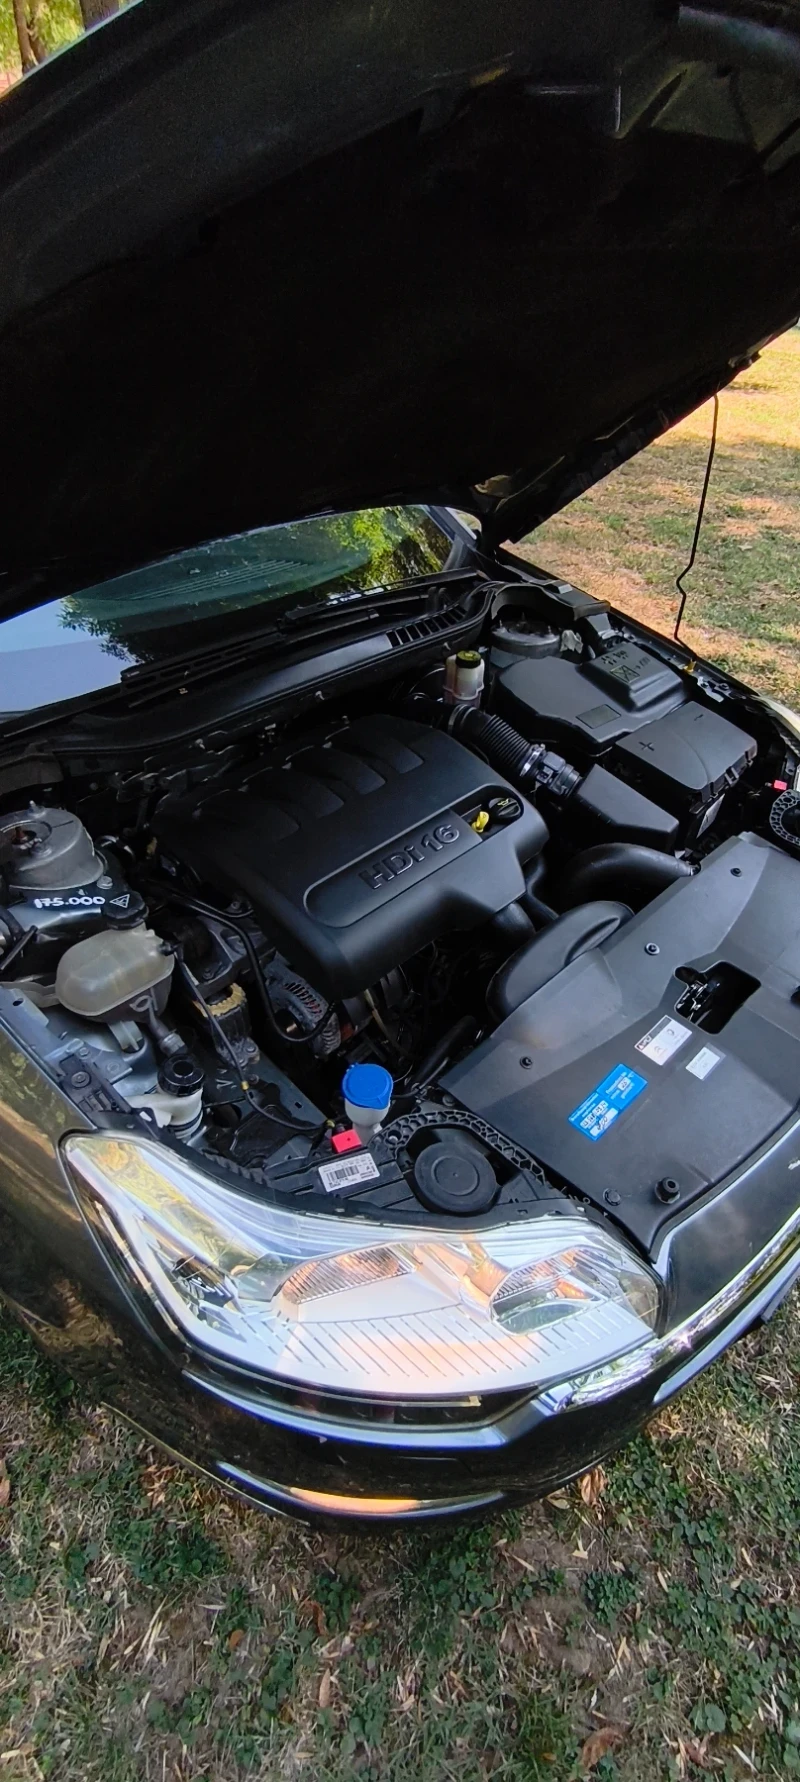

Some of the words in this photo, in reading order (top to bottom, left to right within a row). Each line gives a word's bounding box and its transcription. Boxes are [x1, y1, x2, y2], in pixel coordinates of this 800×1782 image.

[358, 845, 426, 889] HDi
[421, 824, 460, 851] 16
[34, 896, 105, 909] 175.000
